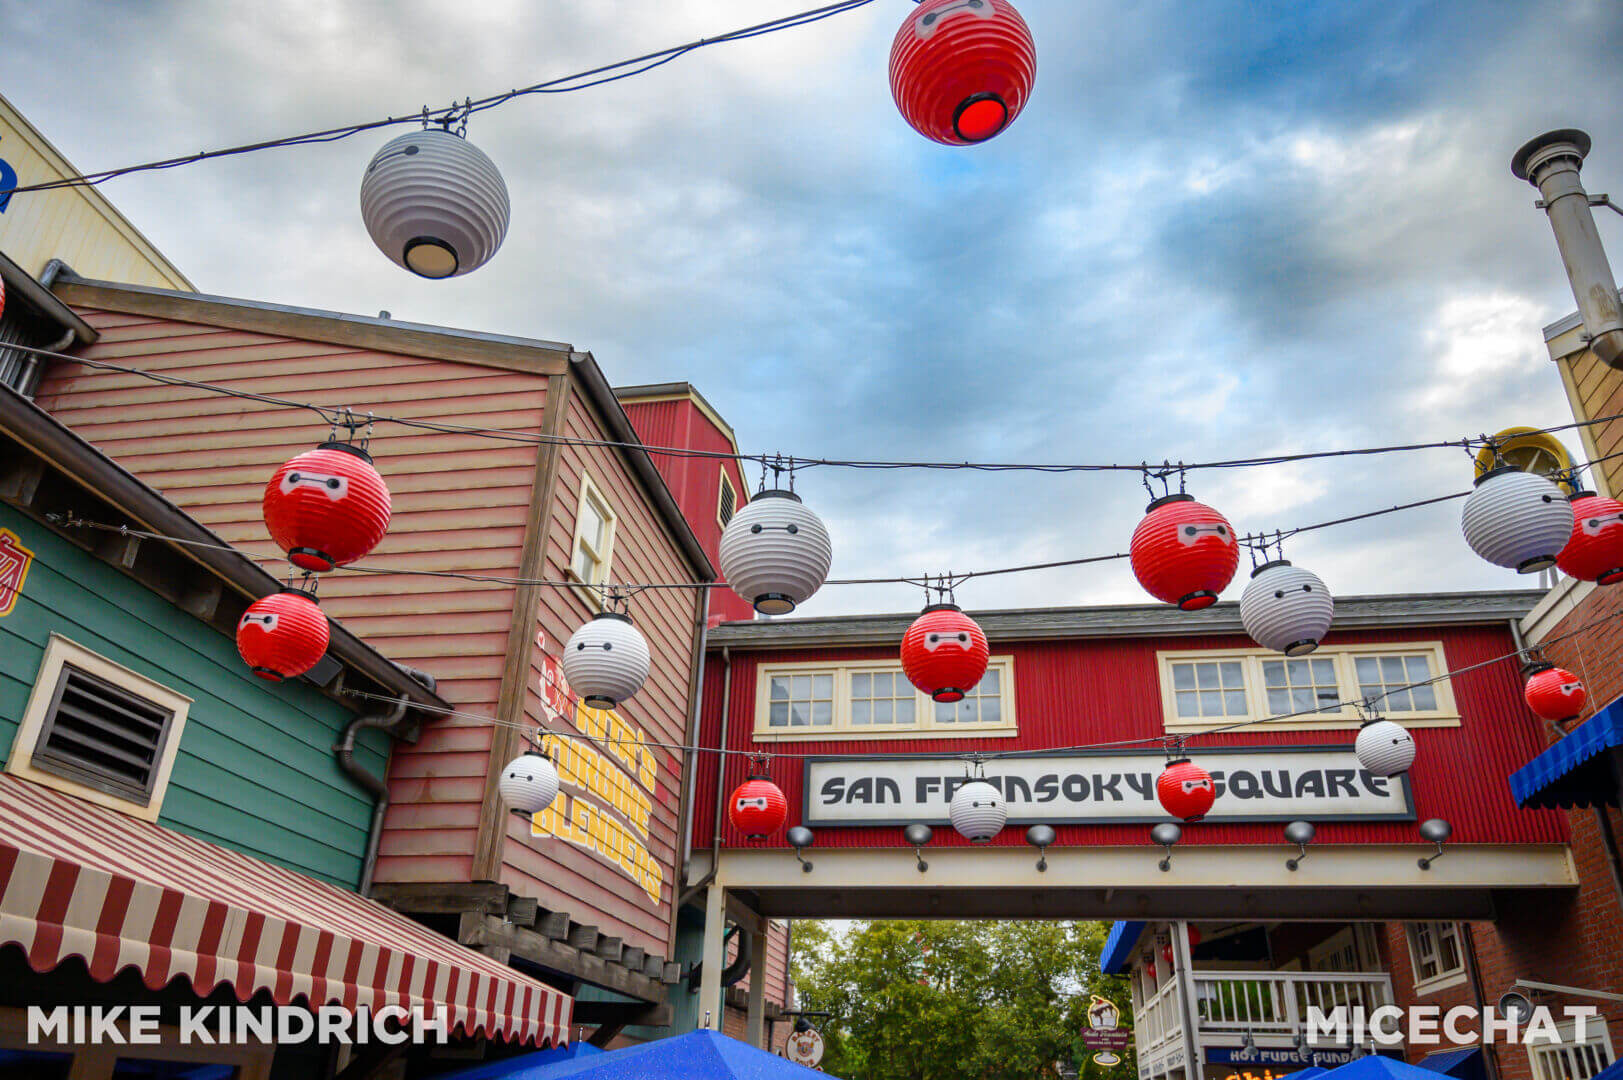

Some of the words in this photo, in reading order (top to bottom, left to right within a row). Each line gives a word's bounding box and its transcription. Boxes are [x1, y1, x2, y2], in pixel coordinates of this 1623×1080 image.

[537, 731, 653, 840] TURBINE
[576, 697, 657, 795] RITA'S
[820, 776, 901, 805] SAN
[531, 791, 664, 907] BLENDERS
[1260, 1051, 1309, 1063] FUDGE
